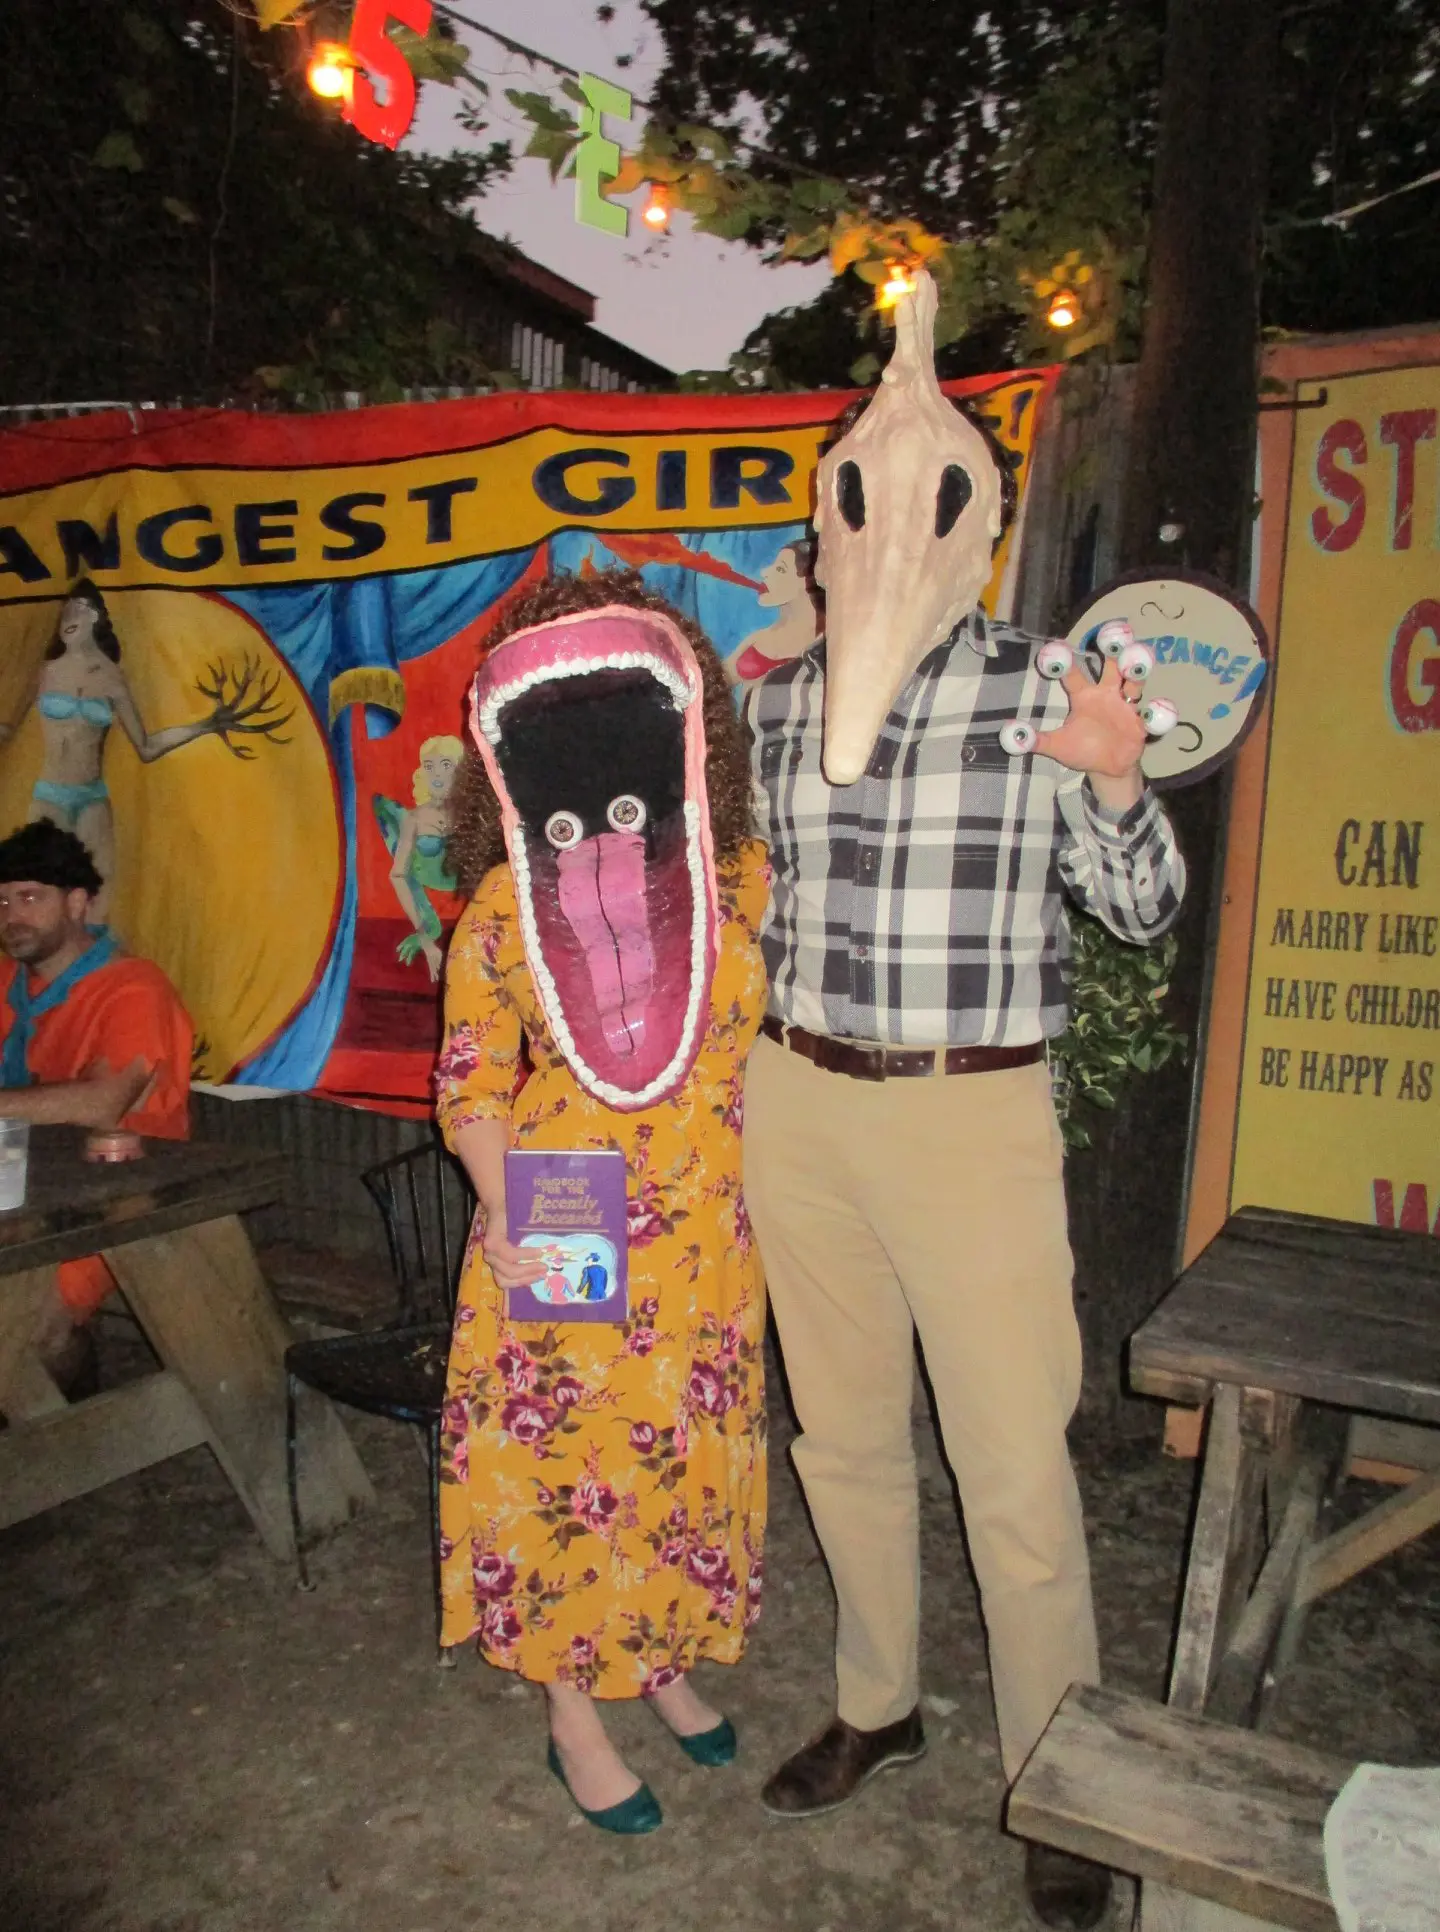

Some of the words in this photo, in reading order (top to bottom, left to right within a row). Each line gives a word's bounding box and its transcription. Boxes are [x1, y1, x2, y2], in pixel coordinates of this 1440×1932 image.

[532, 444, 832, 517] GIR
[1333, 817, 1424, 889] CAN
[1269, 908, 1370, 952] MARRY
[1378, 913, 1438, 957] LIKE
[1264, 976, 1337, 1021] HAVE
[1259, 1046, 1291, 1088] BE
[1298, 1050, 1389, 1097] HAPPY
[1397, 1060, 1435, 1104] AS
